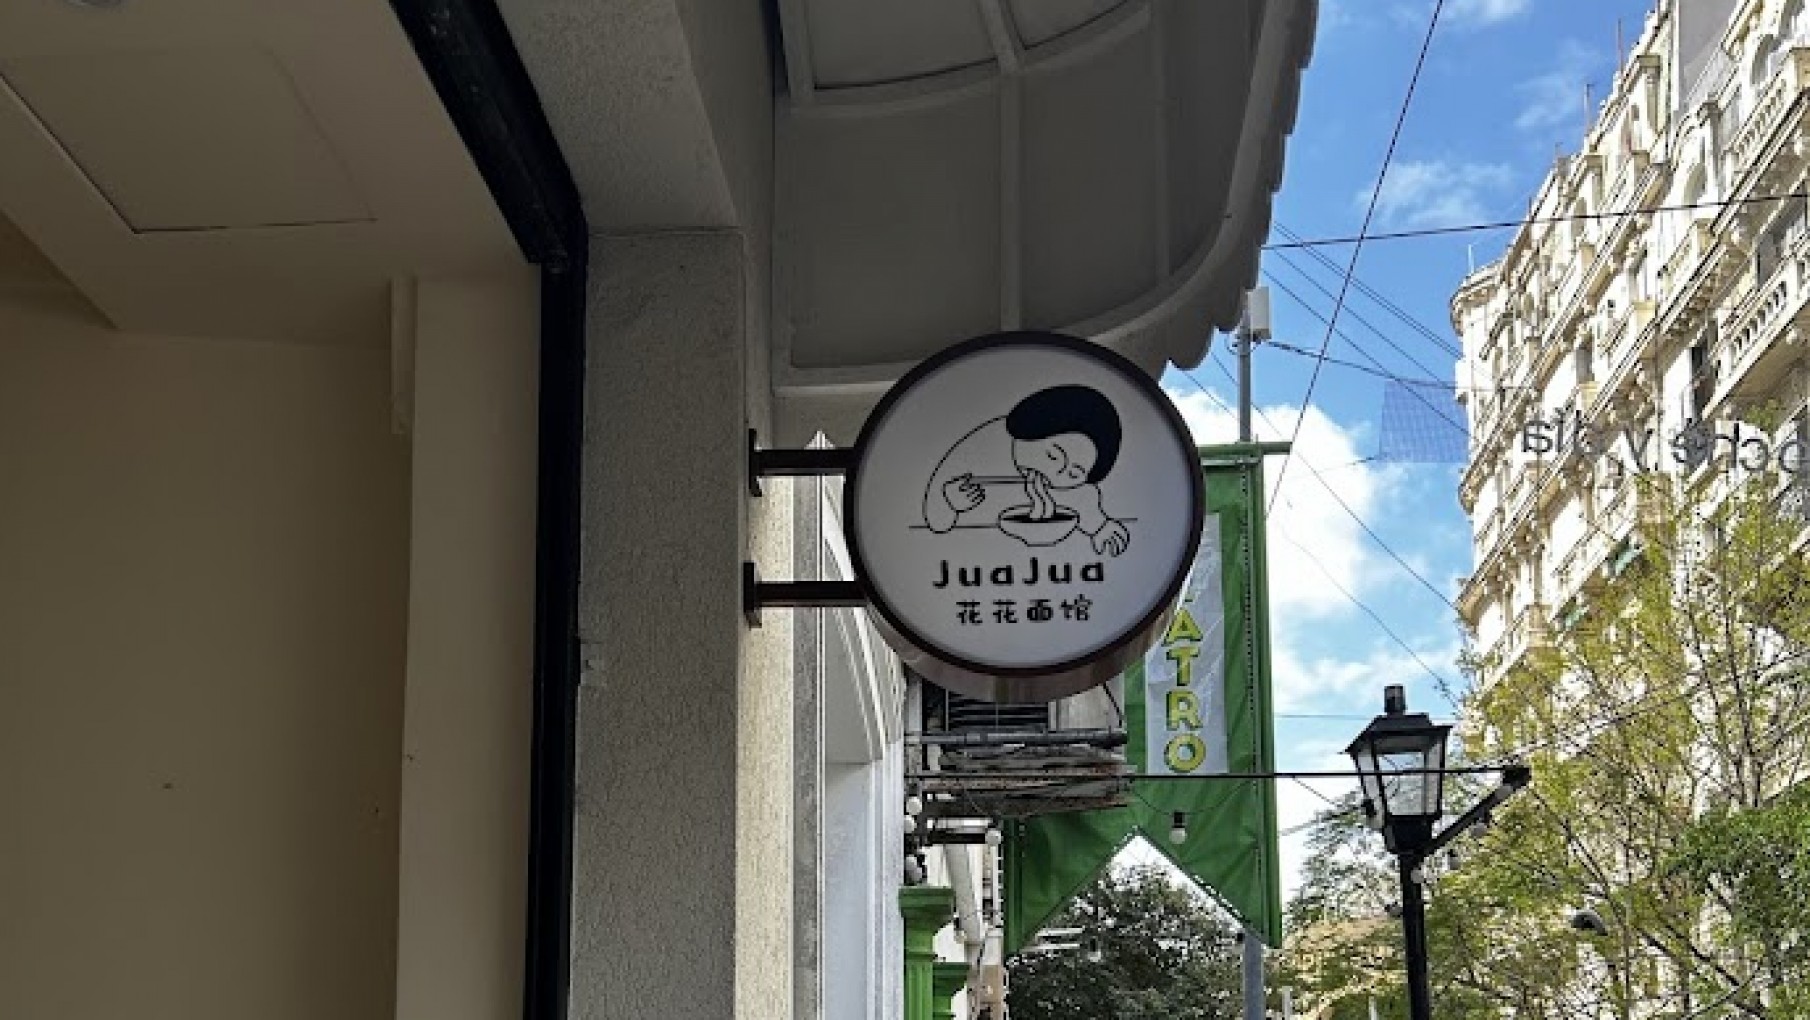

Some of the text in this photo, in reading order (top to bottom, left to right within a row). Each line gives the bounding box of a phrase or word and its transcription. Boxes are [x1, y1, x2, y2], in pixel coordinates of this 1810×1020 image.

[932, 557, 1104, 589] JuaJua
[955, 594, 1093, 625] 花花面馆
[1162, 599, 1206, 773] ATRO
